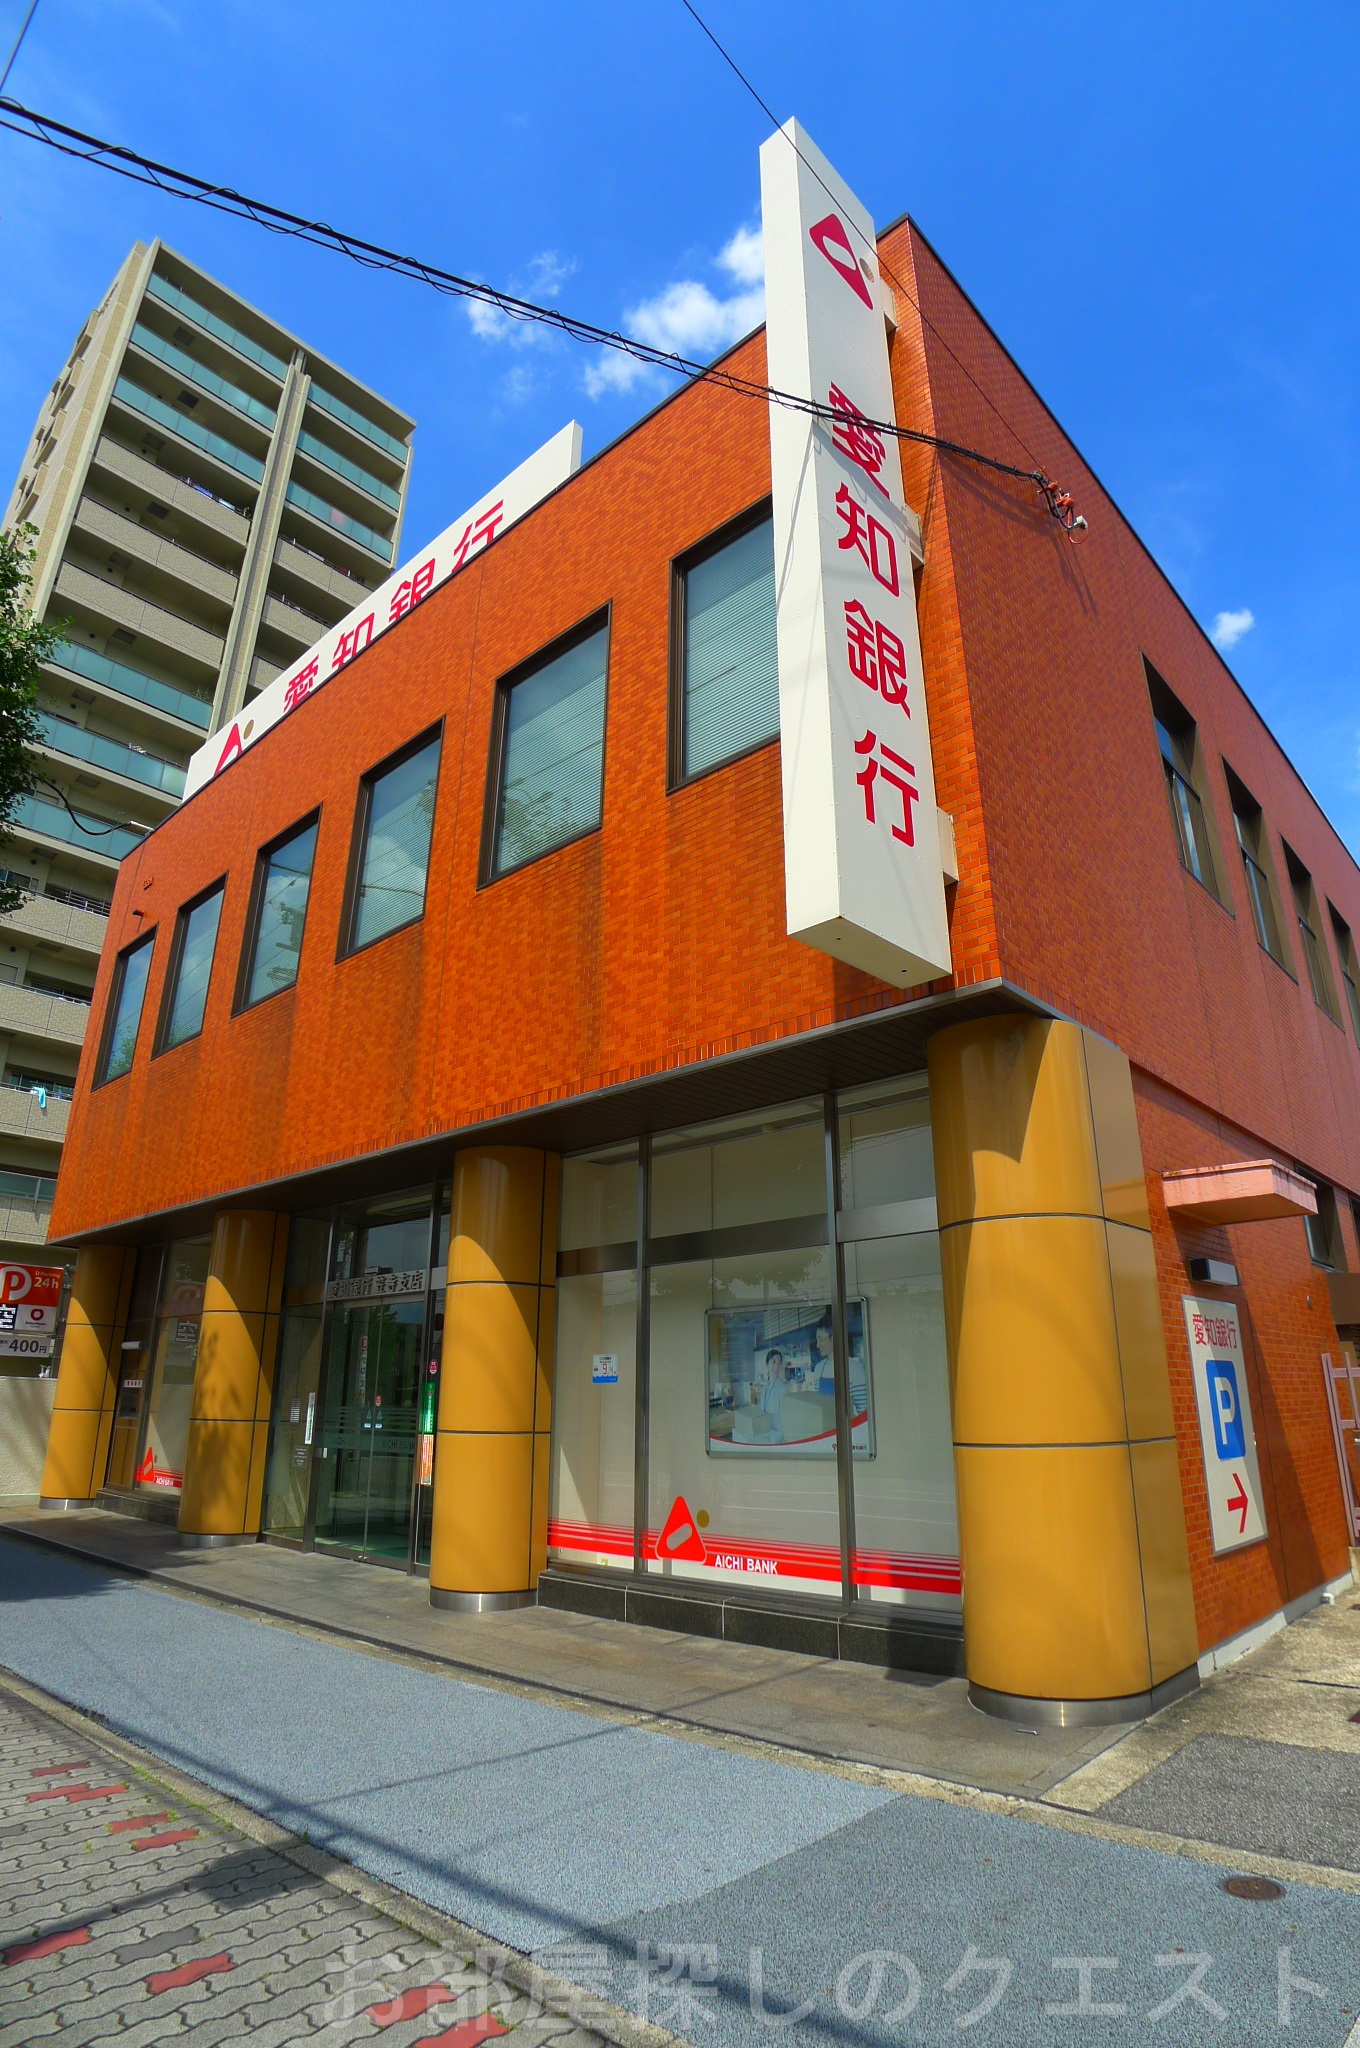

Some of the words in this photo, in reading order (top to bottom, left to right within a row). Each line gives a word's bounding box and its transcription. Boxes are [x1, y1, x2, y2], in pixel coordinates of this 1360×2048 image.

[283, 499, 504, 713] 愛知銀行
[829, 381, 919, 848] 愛知銀行
[33, 1277, 59, 1289] 24h
[9, 1339, 47, 1354] 400円
[1192, 1313, 1238, 1349] 愛知銀行
[1214, 1376, 1236, 1445] P
[715, 1554, 744, 1571] AICHI
[746, 1557, 778, 1575] BANK
